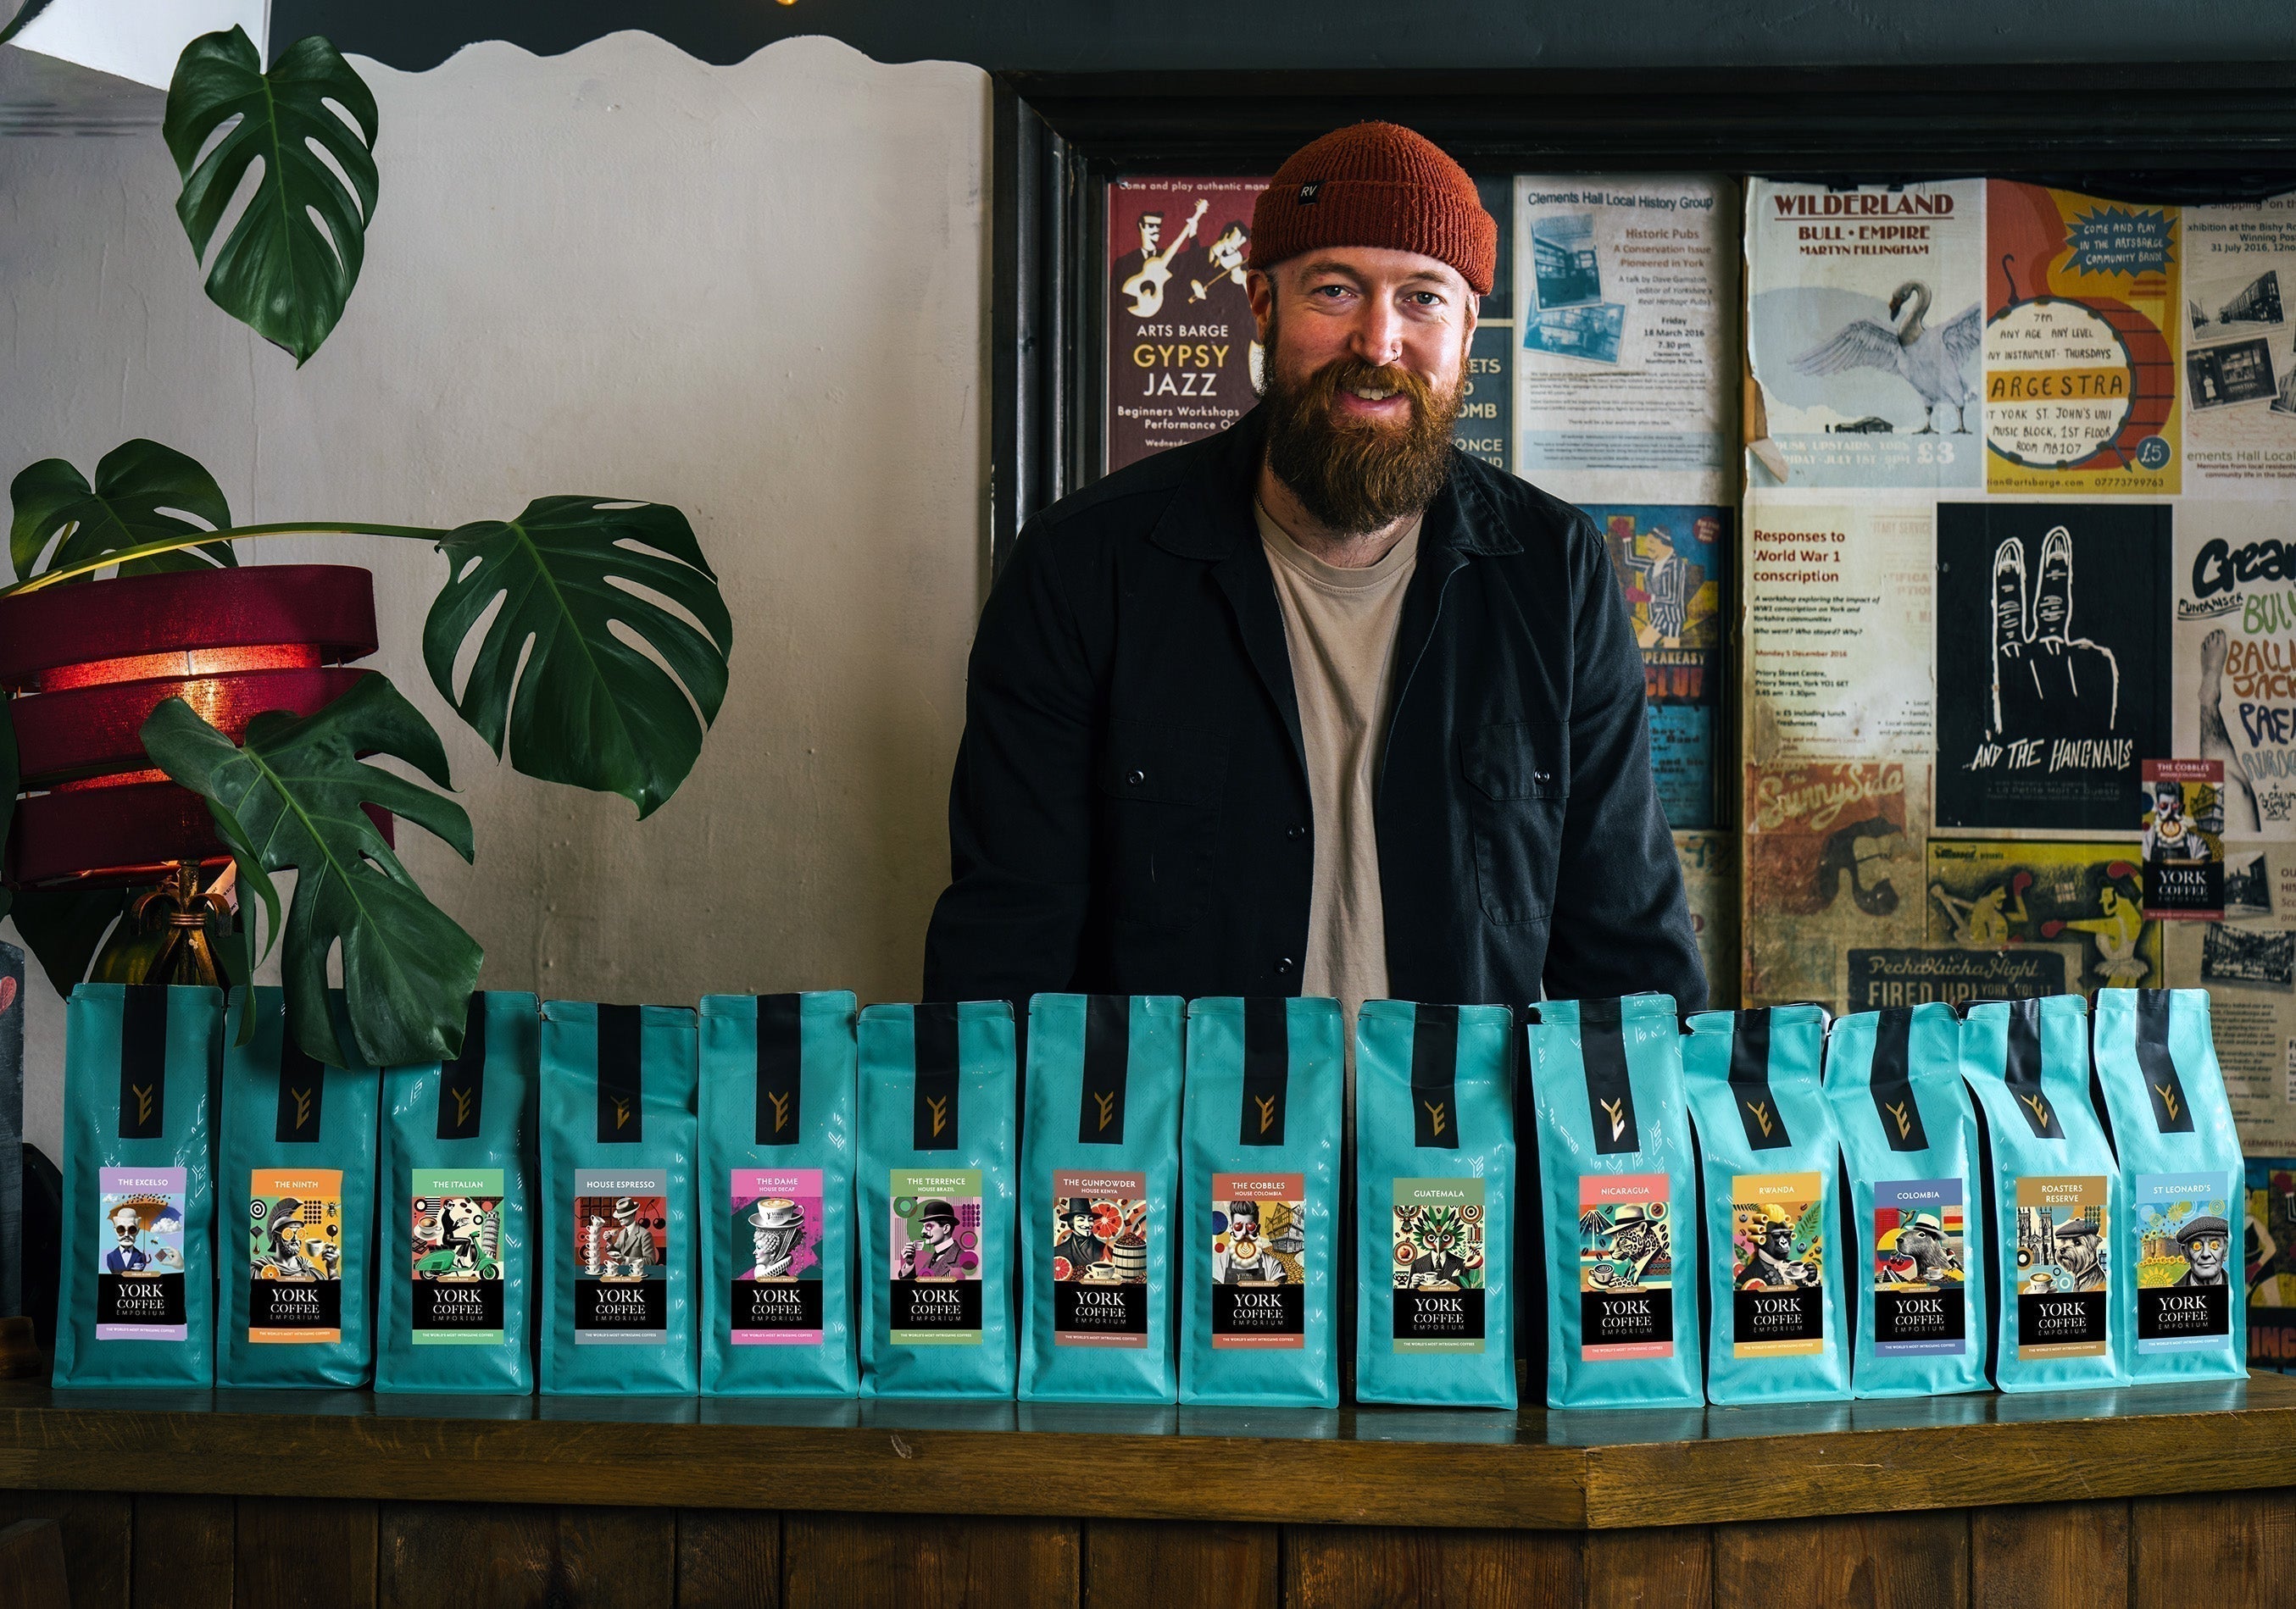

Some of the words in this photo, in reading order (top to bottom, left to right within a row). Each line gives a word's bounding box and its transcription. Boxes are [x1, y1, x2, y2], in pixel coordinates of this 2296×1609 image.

[1150, 181, 1168, 190] and
[1172, 181, 1192, 191] play
[1197, 181, 1241, 191] authentic
[1301, 186, 1317, 197] RV
[1528, 191, 1579, 205] Clements
[1583, 192, 1603, 204] Hall
[1607, 193, 1635, 207] Local
[1639, 196, 1676, 212] History
[1680, 197, 1713, 210] Group
[1774, 194, 1954, 215] WILDERLAND
[1799, 226, 1844, 240] BULL
[1860, 226, 1930, 240] EMPIRE
[2084, 225, 2109, 234] COME
[2114, 223, 2133, 232] AND
[2138, 223, 2156, 233] PLAY
[2260, 224, 2283, 232] Bishy
[1626, 229, 1668, 239] Historic
[1673, 230, 1699, 239] Pubs
[2240, 234, 2276, 242] Winning
[2081, 241, 2089, 250] IN
[2094, 240, 2109, 249] THE
[2115, 237, 2163, 248] ARTSBARGE
[2225, 244, 2241, 253] July
[1800, 246, 1850, 255] MARTYN
[1854, 245, 1928, 255] FILLINGHAM
[2086, 252, 2135, 264] COMMUNITY
[1662, 317, 1687, 325] Friday
[1137, 325, 1172, 336] ARTS
[1180, 325, 1228, 336] BARGE
[2026, 330, 2041, 338] AGE
[2052, 329, 2068, 338] ANY
[2072, 329, 2093, 338] LEVEL
[1133, 344, 1228, 368] GYPSY
[2065, 349, 2111, 359] THURSDAYS
[1143, 373, 1216, 396] JAZZ
[1118, 407, 1173, 419] Beginners
[1177, 407, 1239, 418] Workshops
[2002, 411, 2027, 419] YORK
[2056, 408, 2090, 419] JOHN'S
[2095, 411, 2111, 419] UNI
[1145, 419, 1215, 430] Performance
[1993, 427, 2018, 436] MUSIC
[2062, 426, 2079, 437] 1ST
[2085, 427, 2110, 437] FLOOR
[1456, 439, 1503, 452] ONCE
[2016, 441, 2037, 452] ROOM
[2043, 443, 2081, 454] MB107
[1917, 441, 1954, 464] £3
[2141, 442, 2161, 463] £5
[1754, 530, 1826, 544] Responses
[1831, 531, 1845, 542] to
[1801, 551, 1828, 562] War
[1833, 551, 1840, 562] 1
[1754, 570, 1838, 584] conscription
[2008, 738, 2044, 769] THE
[2049, 738, 2132, 774] HANGNAILS
[2160, 870, 2206, 884] YORK
[2159, 885, 2208, 896] COFFEE
[1868, 981, 1932, 1007] FIRED
[1760, 1186, 1794, 1195] RWANDA
[119, 1284, 163, 1297] YORK
[272, 1289, 319, 1301] YORK
[434, 1290, 482, 1302] YORK
[597, 1290, 645, 1302] YORK
[753, 1290, 800, 1302] YORK
[912, 1290, 959, 1302] YORK
[117, 1300, 164, 1309] COFFEE
[1076, 1292, 1125, 1306] YORK
[1234, 1295, 1281, 1307] YORK
[2159, 1296, 2207, 1311] YORK
[270, 1304, 320, 1313] COFFEE
[433, 1305, 482, 1314] COFFEE
[596, 1305, 645, 1314] COFFEE
[753, 1306, 802, 1314] COFFEE
[911, 1306, 960, 1314] COFFEE
[1415, 1299, 1463, 1312] YORK
[1603, 1301, 1651, 1315] YORK
[1754, 1298, 1801, 1312] YORK
[1895, 1300, 1943, 1313] YORK
[2039, 1302, 2085, 1316] YORK
[1076, 1307, 1126, 1318] COFFEE
[1233, 1310, 1282, 1318] COFFEE
[2159, 1312, 2208, 1322] COFFEE
[1415, 1314, 1464, 1323] COFFEE
[1603, 1317, 1652, 1327] COFFEE
[1754, 1315, 1802, 1325] COFFEE
[1895, 1315, 1943, 1325] COFFEE
[2039, 1318, 2086, 1328] COFFEE
